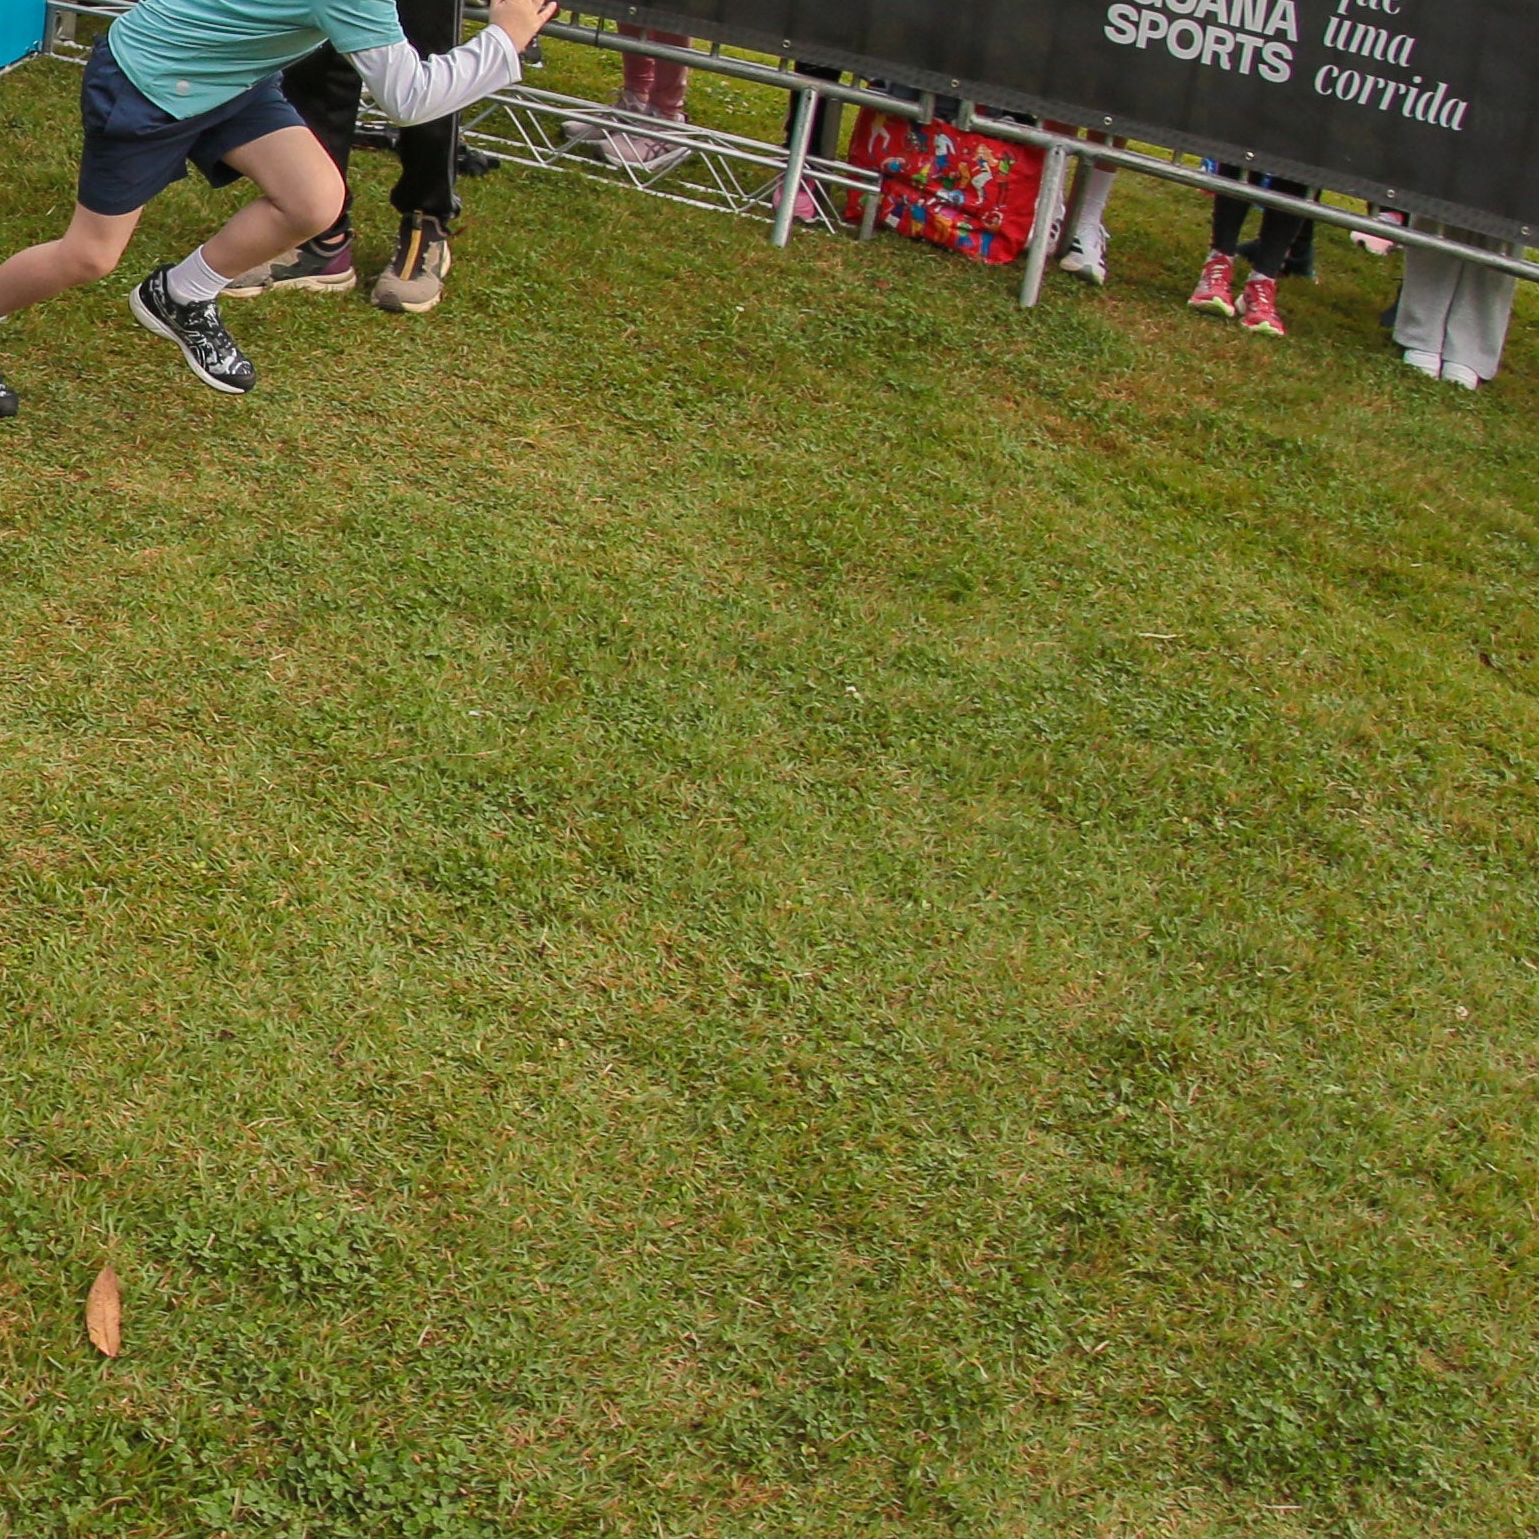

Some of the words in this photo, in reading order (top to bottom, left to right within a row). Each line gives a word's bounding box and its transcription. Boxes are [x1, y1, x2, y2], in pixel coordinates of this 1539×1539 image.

[1104, 3, 1294, 83] SPORTS
[1323, 15, 1416, 67] uma
[1314, 64, 1470, 131] corrida
